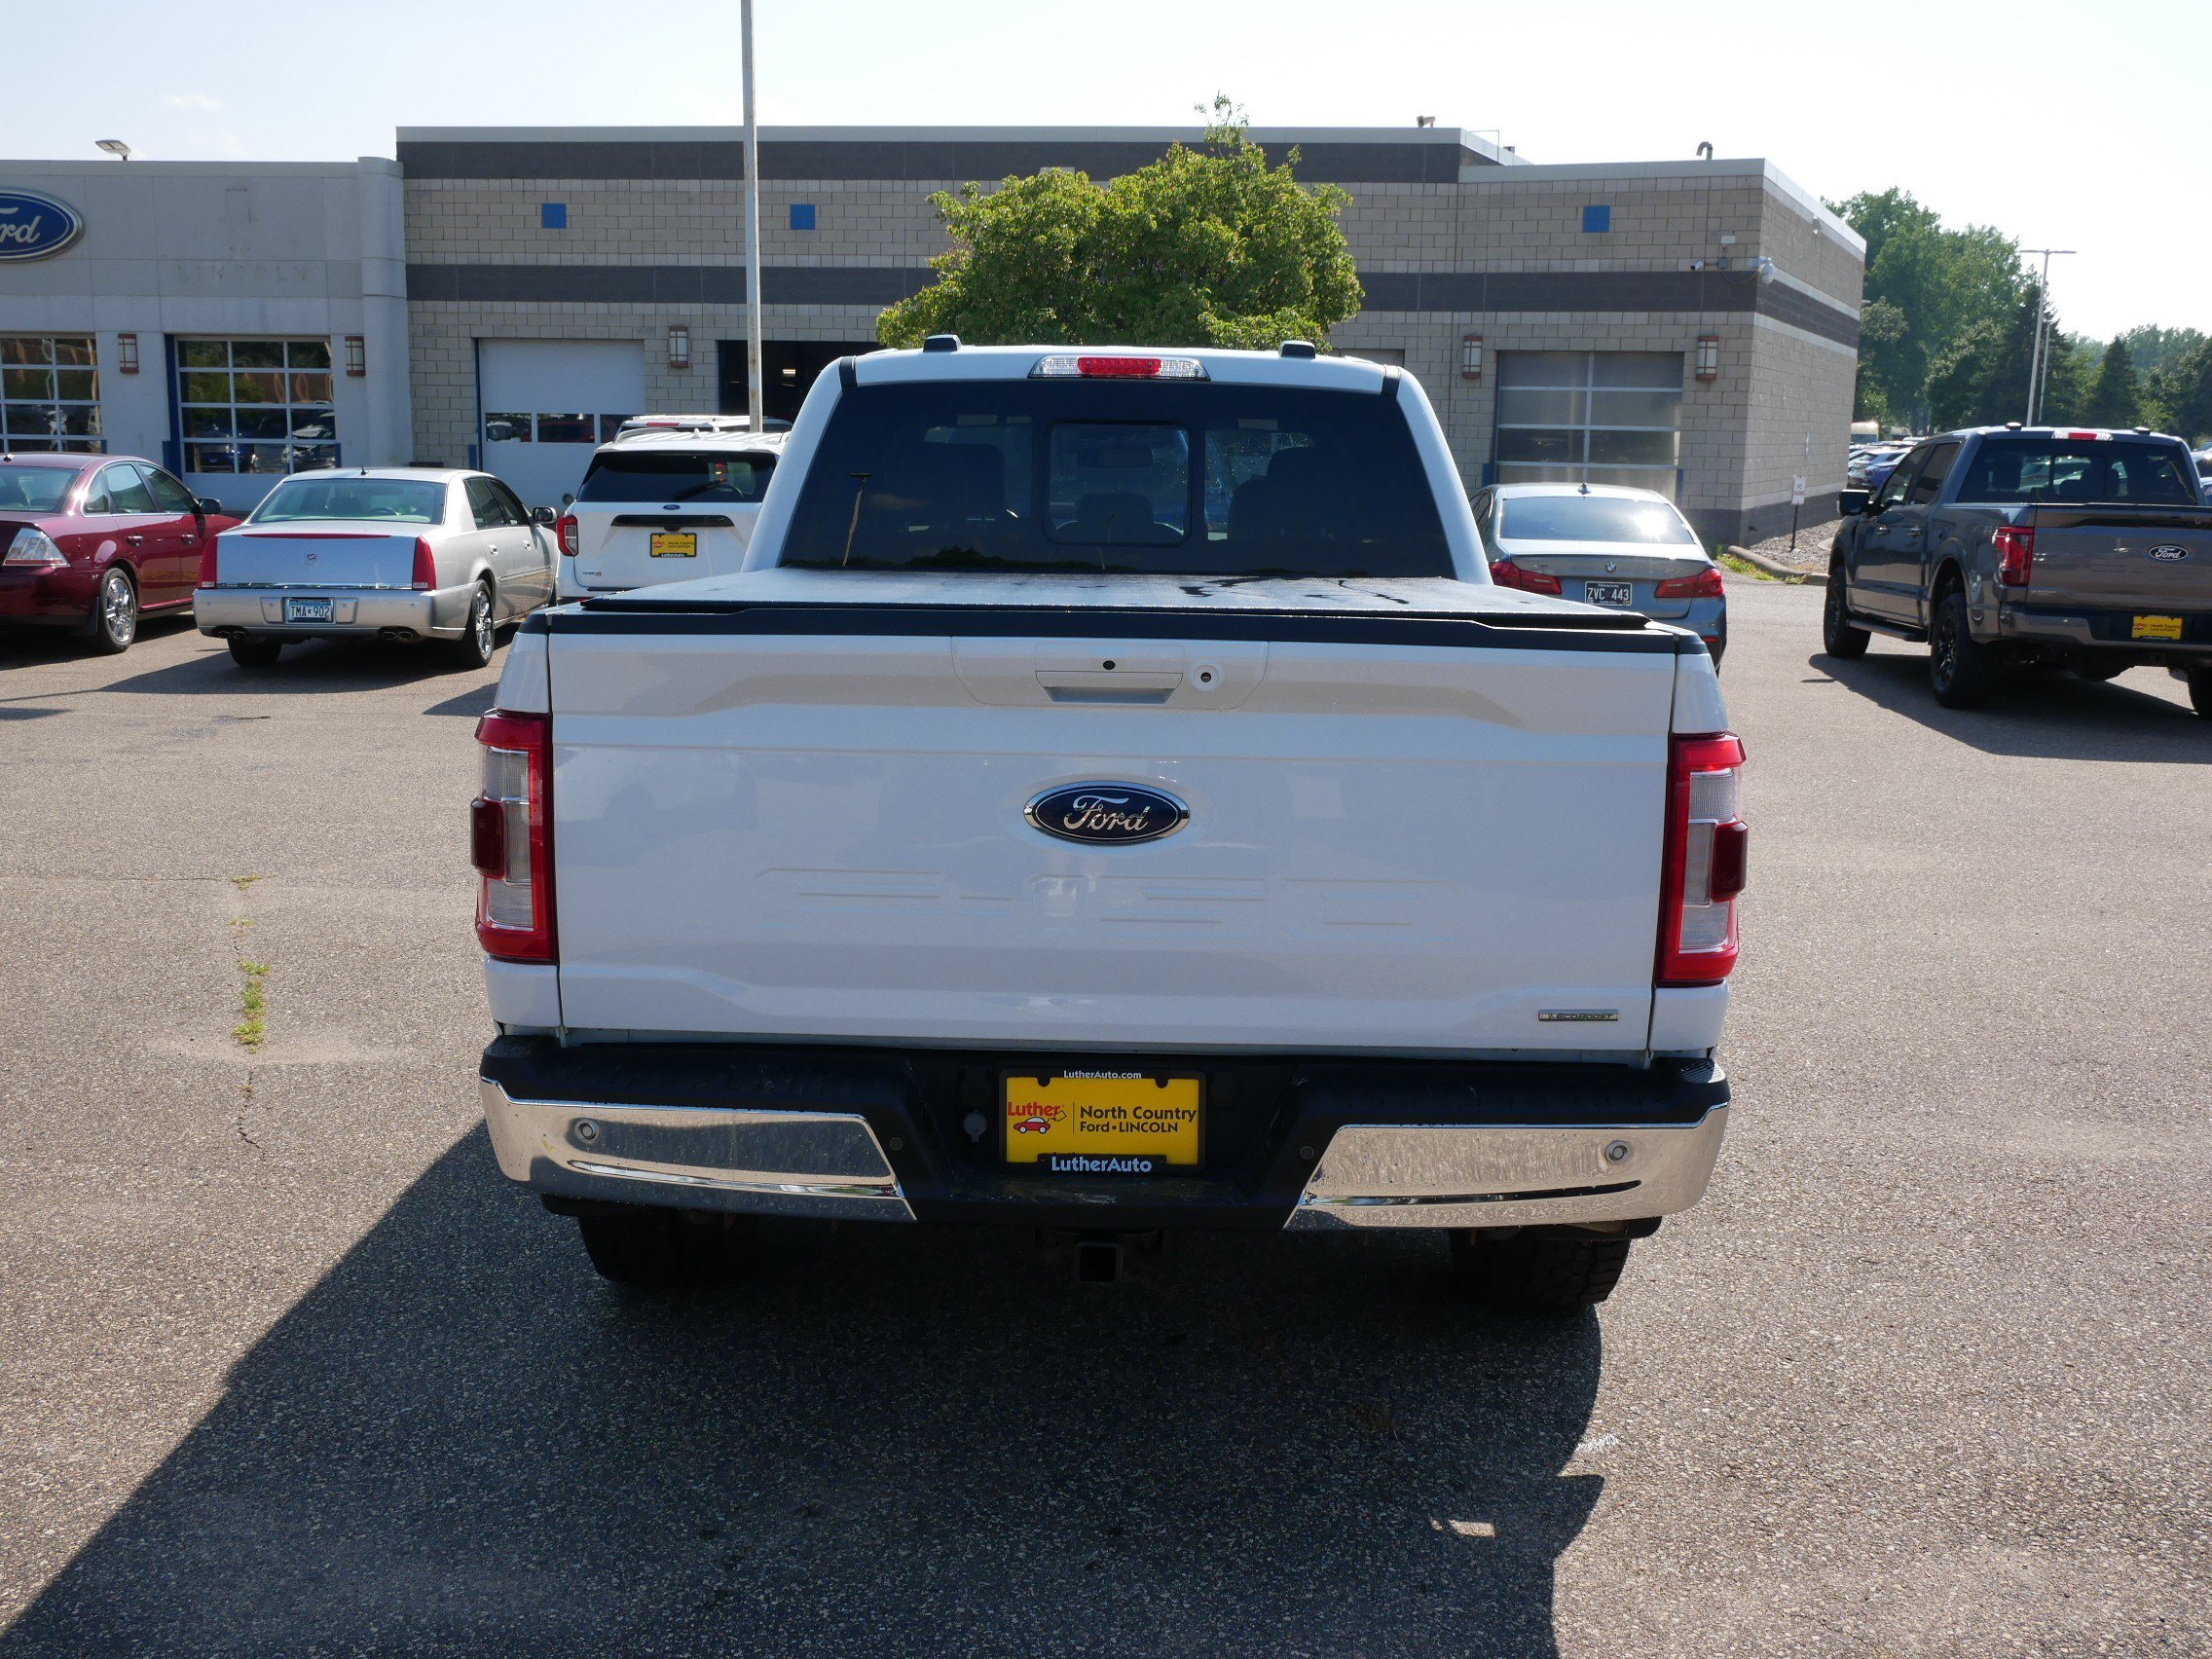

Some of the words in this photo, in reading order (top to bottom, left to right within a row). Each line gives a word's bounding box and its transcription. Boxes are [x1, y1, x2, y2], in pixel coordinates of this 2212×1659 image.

[2155, 547, 2181, 559] Ford
[1587, 587, 1605, 600] ZVC
[1611, 588, 1630, 601] 443
[291, 607, 307, 617] TMA
[313, 606, 330, 617] 902
[1063, 794, 1151, 830] Ford
[1063, 1070, 1142, 1080] LutherAuto.com
[1008, 1101, 1061, 1117] Luther
[1080, 1105, 1127, 1120] North
[1132, 1106, 1197, 1123] Country
[1051, 1156, 1153, 1172] LutherAuto
